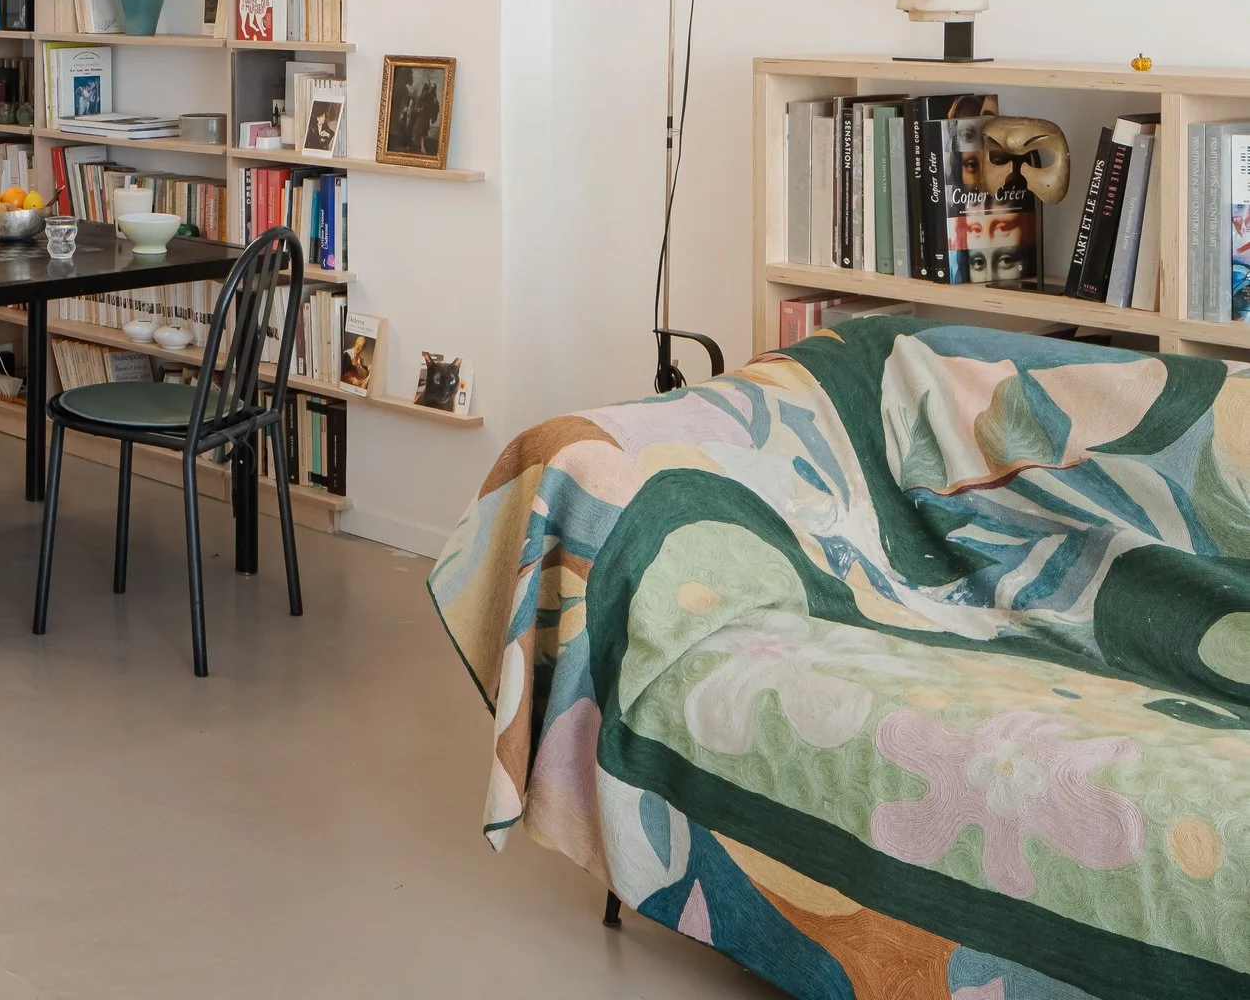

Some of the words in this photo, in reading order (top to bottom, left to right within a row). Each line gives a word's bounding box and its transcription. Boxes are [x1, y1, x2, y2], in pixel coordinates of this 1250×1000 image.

[844, 120, 852, 169] SENSATION
[914, 145, 920, 155] au
[929, 151, 939, 174] Créer
[930, 176, 942, 203] Copier
[1089, 160, 1105, 196] TEMPS
[952, 187, 989, 204] Copier
[994, 185, 1027, 201] Créer
[1086, 199, 1096, 213] LE
[1081, 215, 1092, 231] ET
[1073, 232, 1088, 265] L'ART
